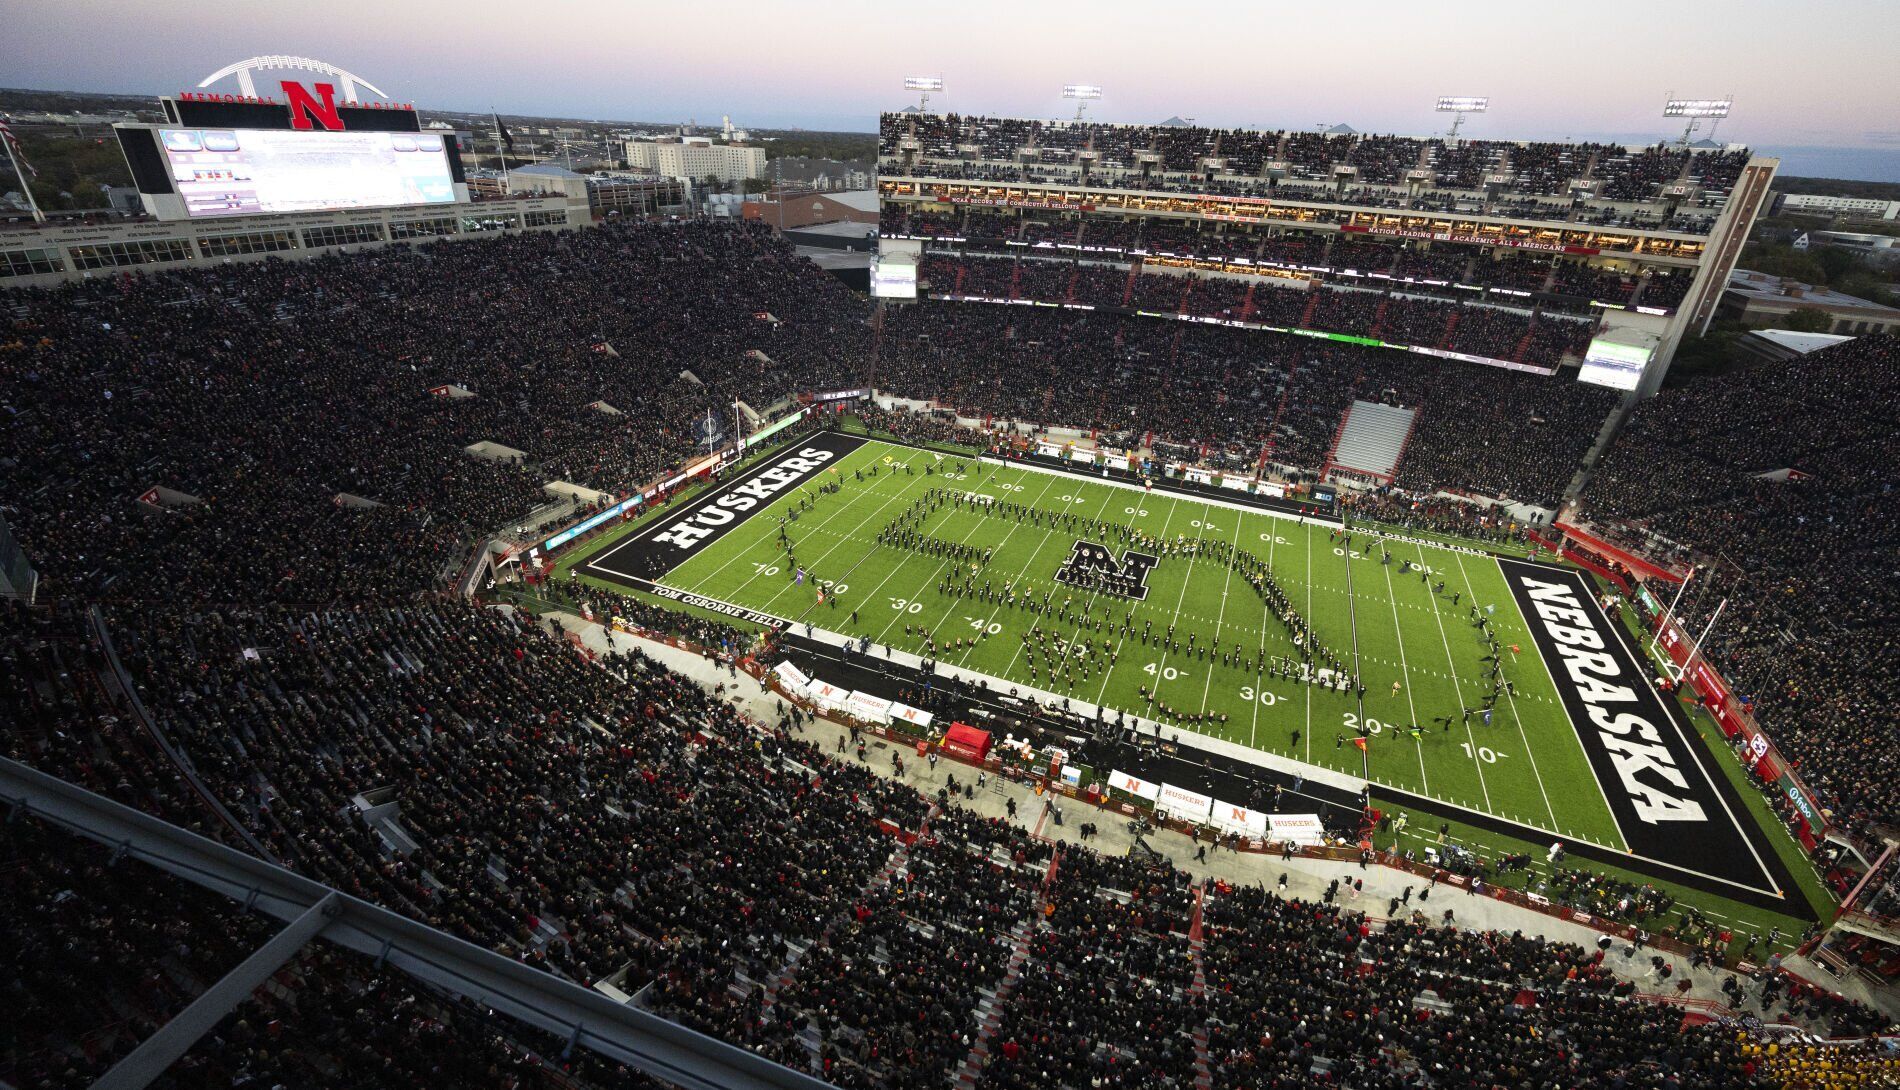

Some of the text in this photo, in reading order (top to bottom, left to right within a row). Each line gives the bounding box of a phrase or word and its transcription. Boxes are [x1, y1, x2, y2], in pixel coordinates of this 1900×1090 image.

[180, 91, 413, 111] MEMORIAL STADIUM
[280, 81, 345, 131] N
[1368, 228, 1396, 236] NATION
[1399, 230, 1431, 238] LEADING
[1454, 236, 1496, 245] ACADEMIC
[1516, 241, 1566, 252] AMERICANS
[944, 472, 968, 481] 20
[1002, 483, 1025, 492] 30
[652, 447, 834, 550] HUSKERS
[1062, 495, 1085, 504] 40
[1124, 507, 1149, 518] 50
[1191, 520, 1216, 532] 40
[1260, 533, 1286, 545] 30
[1352, 526, 1380, 535] TOM
[1385, 533, 1445, 547] OSBORNE
[754, 564, 780, 576] 10
[1054, 540, 1160, 600] N
[651, 586, 783, 628] TOM OSBORNE FIELD
[892, 599, 922, 614] 30
[970, 619, 1002, 634] 40
[1143, 662, 1178, 680] 40
[820, 685, 834, 697] N
[1239, 686, 1276, 706] 30
[852, 694, 885, 710] HUSKERS
[1520, 576, 1708, 825] NEBRASKA
[903, 709, 917, 720] N
[1343, 713, 1382, 734] 20
[1461, 742, 1496, 764] 10
[1125, 778, 1141, 792] N
[1165, 789, 1205, 807] HUSKERS
[1231, 808, 1247, 821] N
[1796, 799, 1812, 818] fnbo
